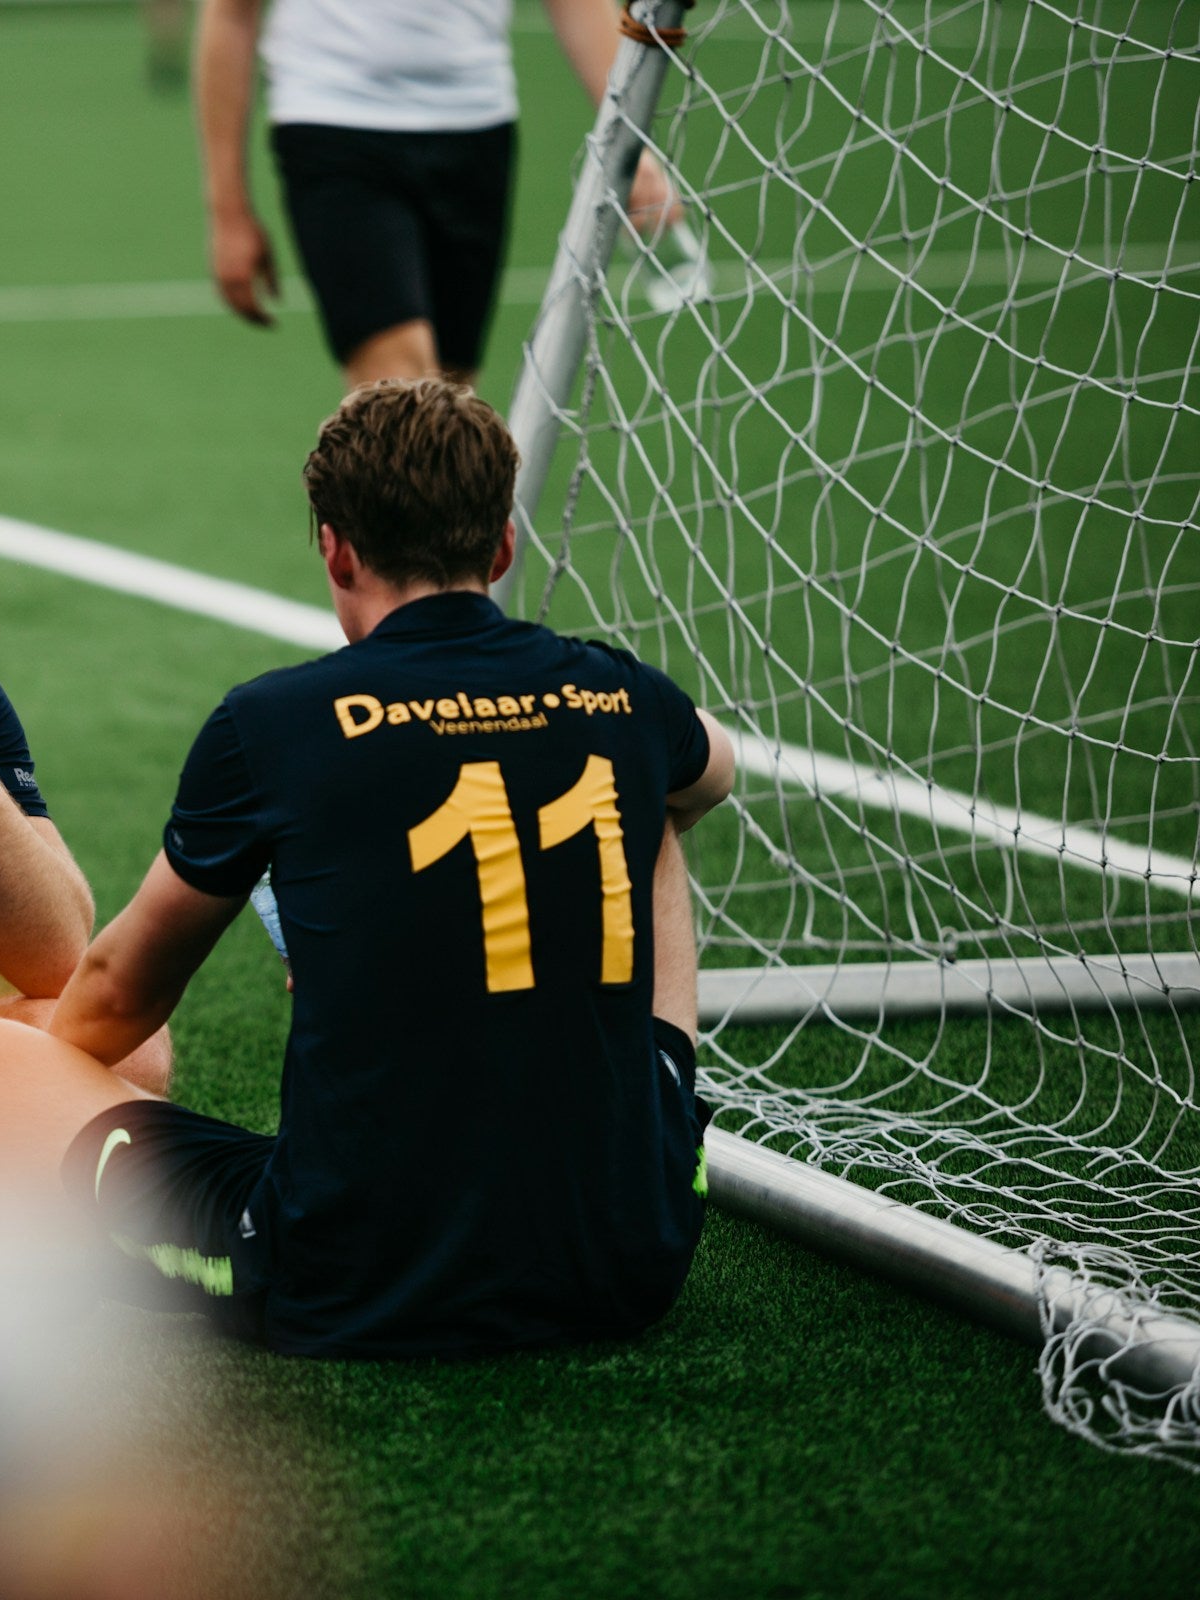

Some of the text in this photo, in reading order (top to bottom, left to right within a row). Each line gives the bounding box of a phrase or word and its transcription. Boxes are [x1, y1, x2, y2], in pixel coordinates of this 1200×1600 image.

[334, 684, 632, 739] Davelaar Sport
[429, 713, 549, 736] Veenendaal
[407, 753, 635, 993] 11
